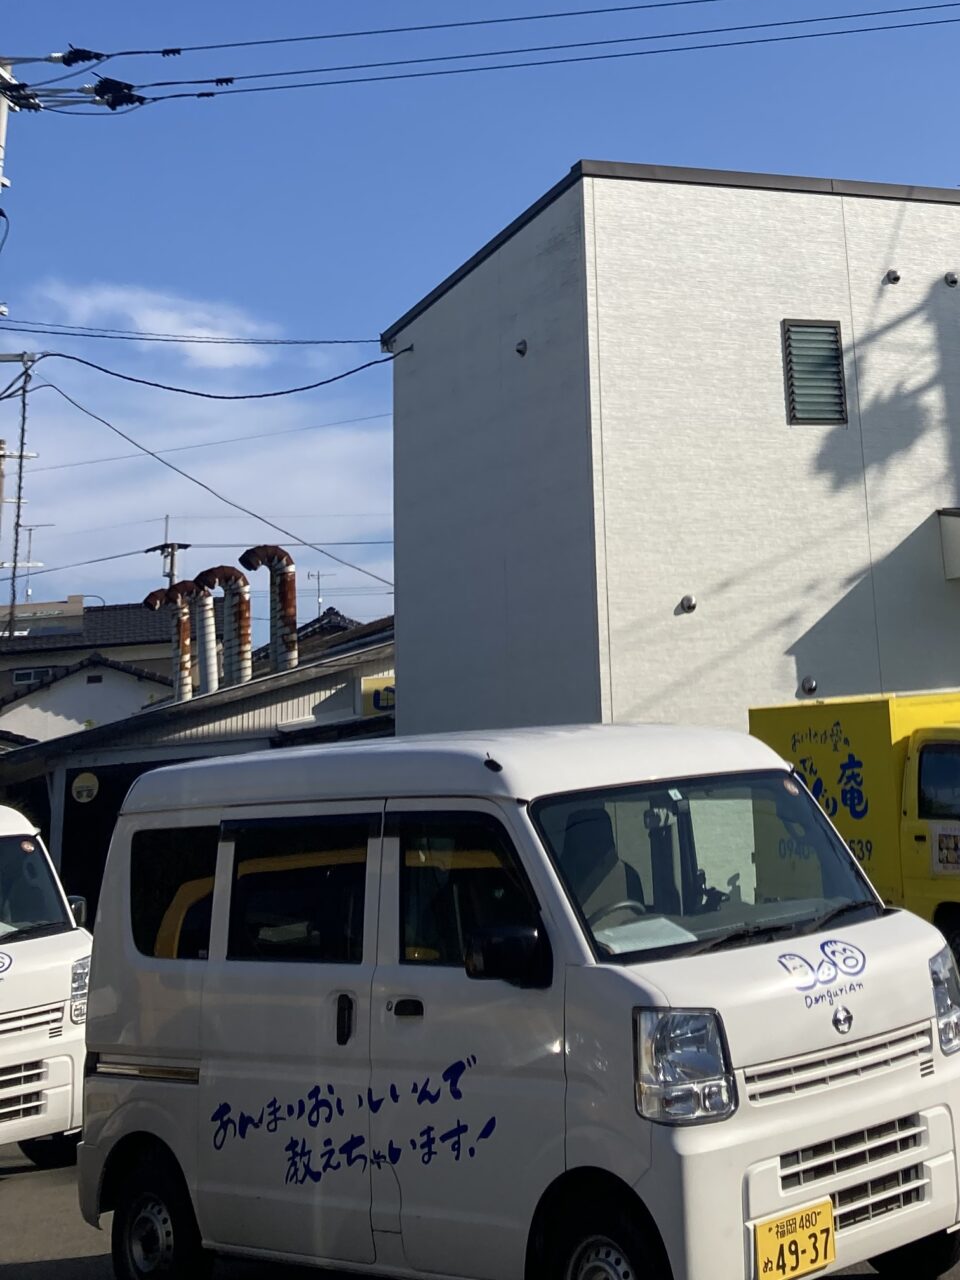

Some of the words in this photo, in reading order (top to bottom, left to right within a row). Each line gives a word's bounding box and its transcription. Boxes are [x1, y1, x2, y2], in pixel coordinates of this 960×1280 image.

[211, 1055, 477, 1150] あんまりおいしいんで
[775, 1217, 797, 1239] 福岡
[798, 1211, 817, 1230] 480
[776, 1227, 830, 1275] 49-37
